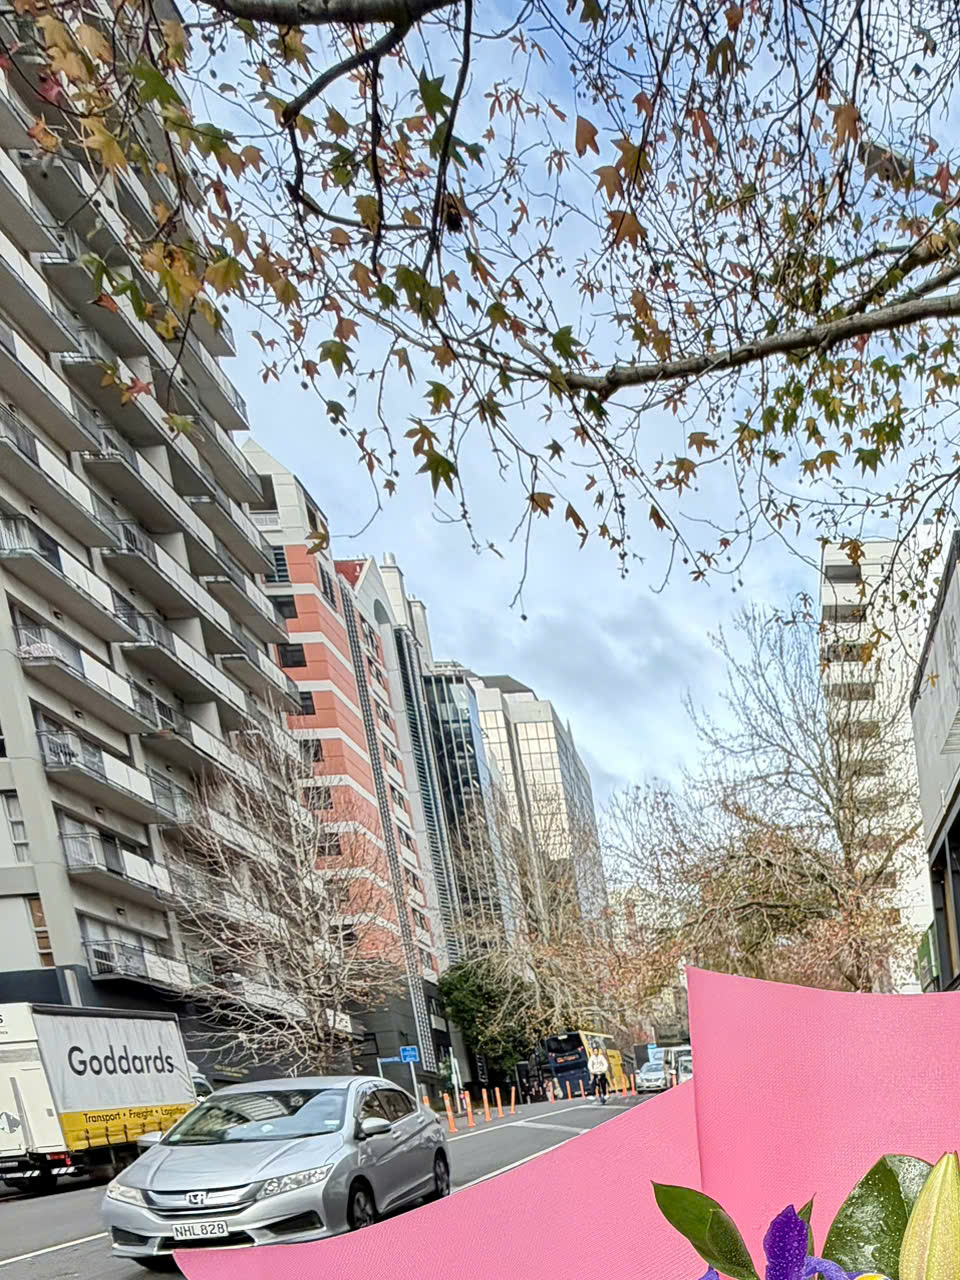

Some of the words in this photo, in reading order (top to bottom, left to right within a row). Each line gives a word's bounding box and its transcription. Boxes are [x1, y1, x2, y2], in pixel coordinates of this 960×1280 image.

[67, 1044, 175, 1077] Goddards
[83, 1112, 121, 1124] Transport
[174, 1223, 226, 1238] NHL828
